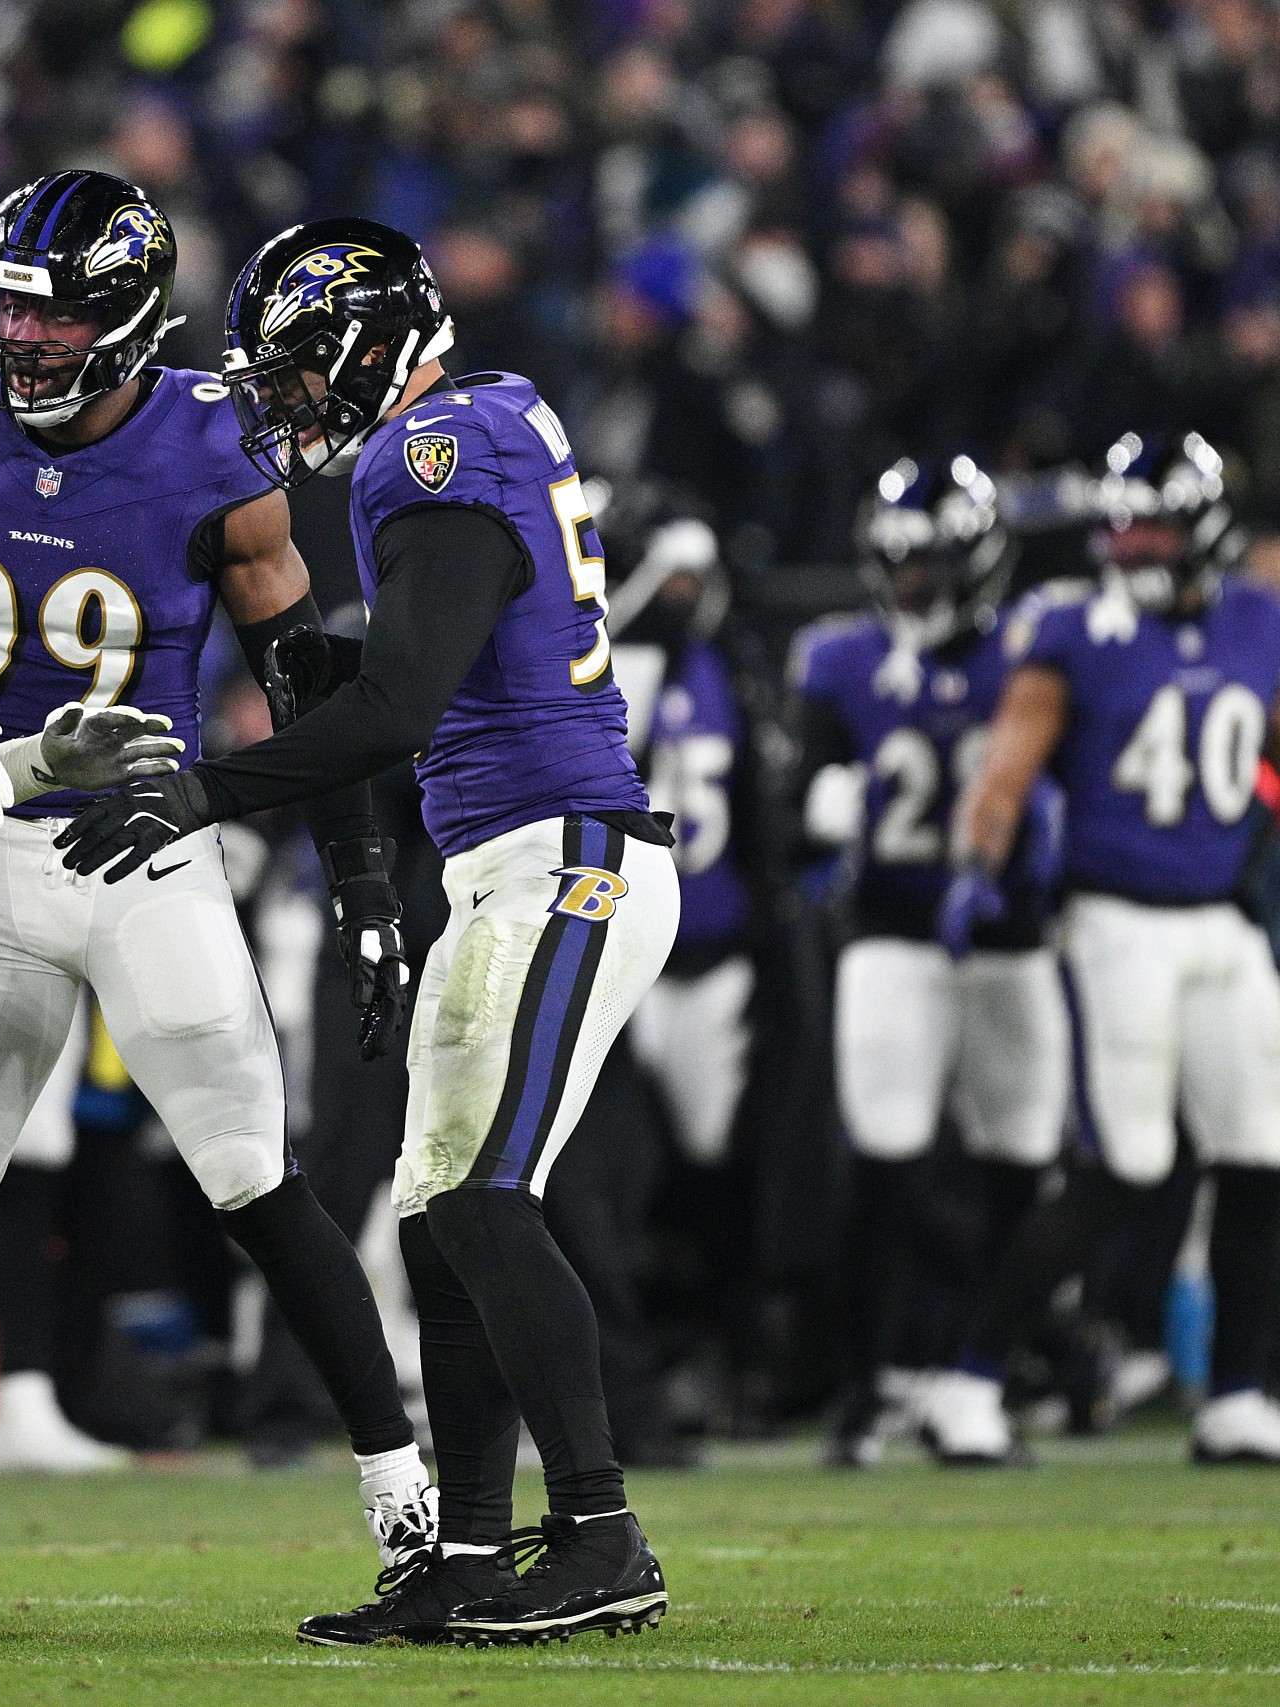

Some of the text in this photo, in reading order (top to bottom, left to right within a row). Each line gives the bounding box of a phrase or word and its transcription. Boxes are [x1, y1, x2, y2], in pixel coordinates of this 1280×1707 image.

[255, 347, 282, 361] OAKLEY
[410, 436, 452, 448] RAVENS
[39, 479, 57, 492] NFL
[8, 530, 75, 549] RAVENS
[1113, 681, 1268, 828] 40
